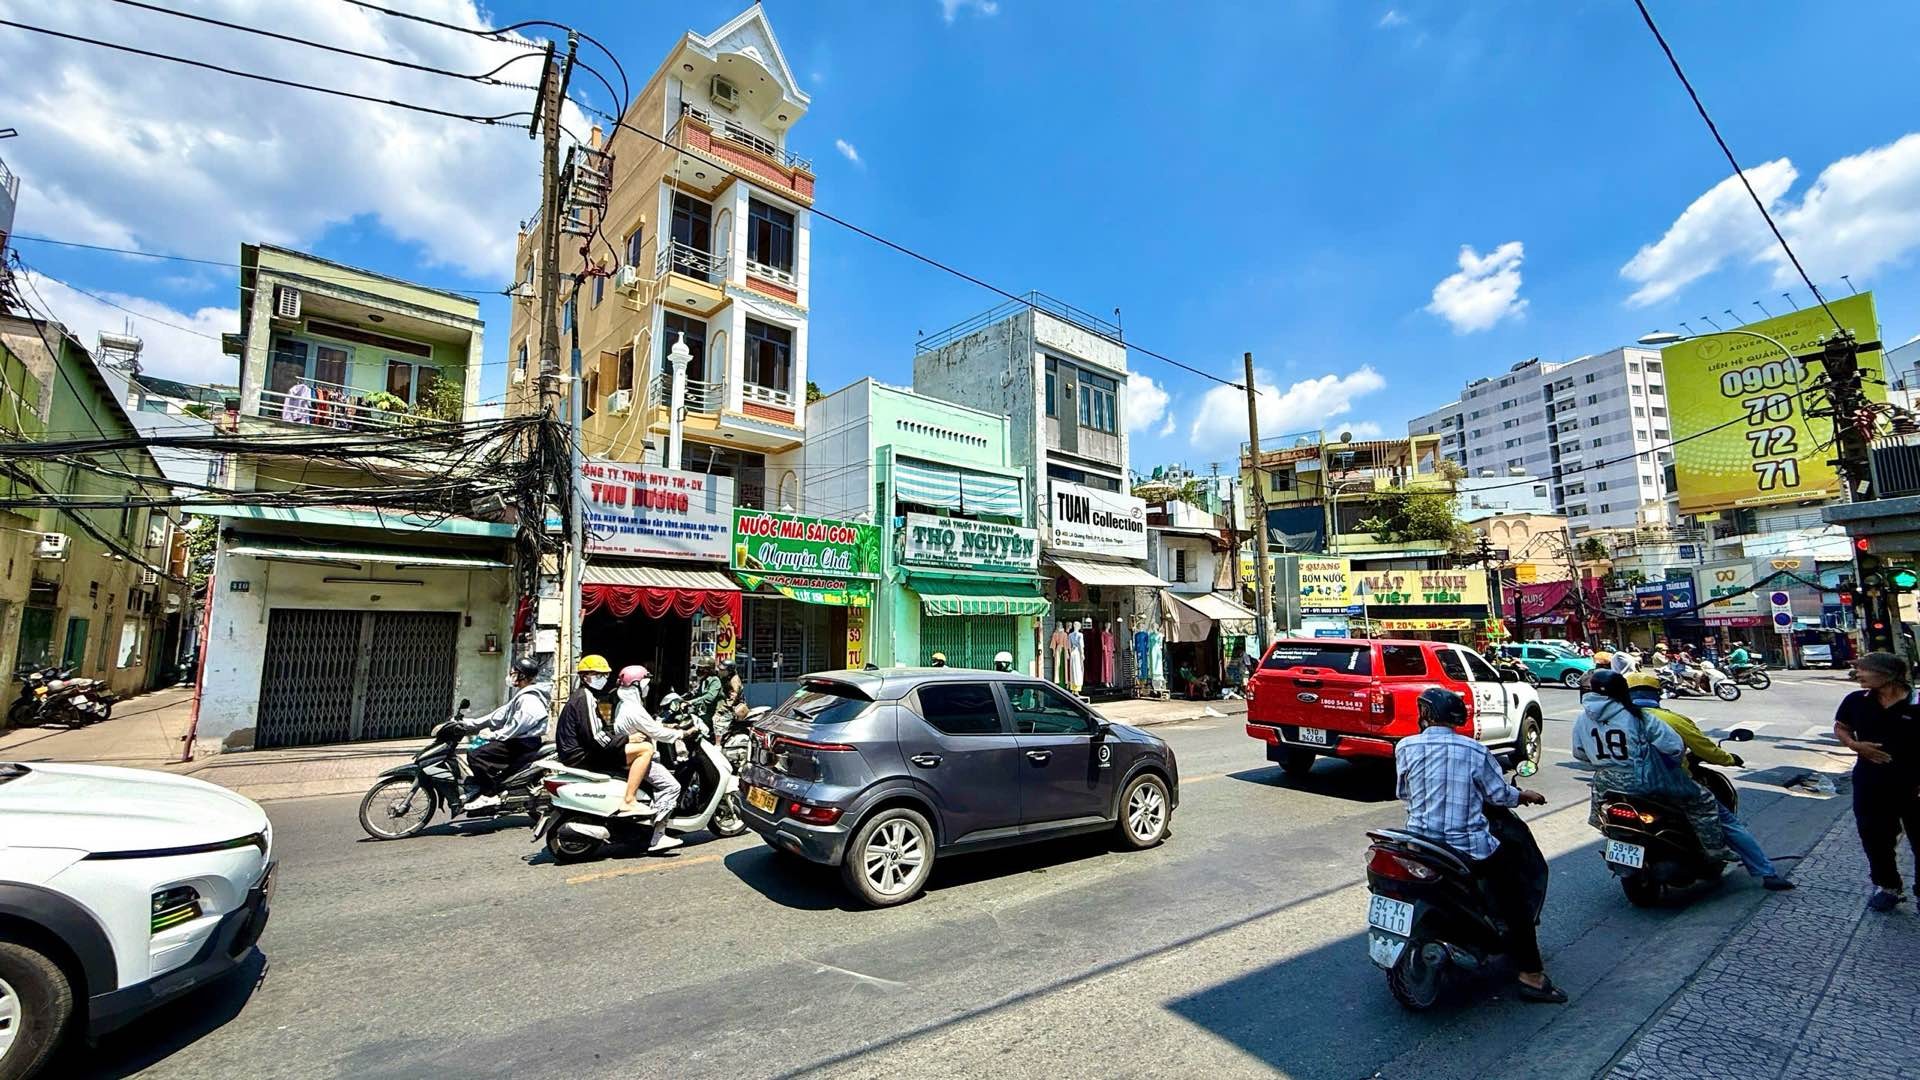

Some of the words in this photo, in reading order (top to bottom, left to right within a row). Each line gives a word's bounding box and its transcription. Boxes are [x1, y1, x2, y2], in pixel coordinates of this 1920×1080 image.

[1742, 392, 1792, 426] 70
[1746, 425, 1798, 458] 72
[608, 469, 618, 479] TY
[649, 474, 669, 486] MTV
[1754, 458, 1800, 491] 71
[591, 482, 628, 507] THU
[632, 485, 689, 513] HƯƠNG
[1057, 491, 1091, 525] TUAN
[737, 513, 779, 537] NƯỚC
[780, 515, 804, 542] MÍA
[806, 520, 827, 545] SÀI
[828, 523, 857, 545] GÒN
[913, 526, 956, 550] THỌ
[962, 531, 1034, 555] NGUYÊN
[758, 542, 818, 570] Nguyên
[820, 547, 851, 571] Chất
[1305, 562, 1340, 571] QUANG
[1364, 569, 1405, 590] MẮT
[1421, 571, 1467, 590] KÍNH
[1374, 591, 1411, 604] VIỆT
[1423, 588, 1461, 604] TIẾN
[1591, 728, 1629, 760] 18
[1608, 850, 1640, 867] 041.11
[1612, 842, 1639, 856] 59-P2
[1373, 912, 1404, 932] 3110
[1376, 898, 1405, 917] 54-X4
